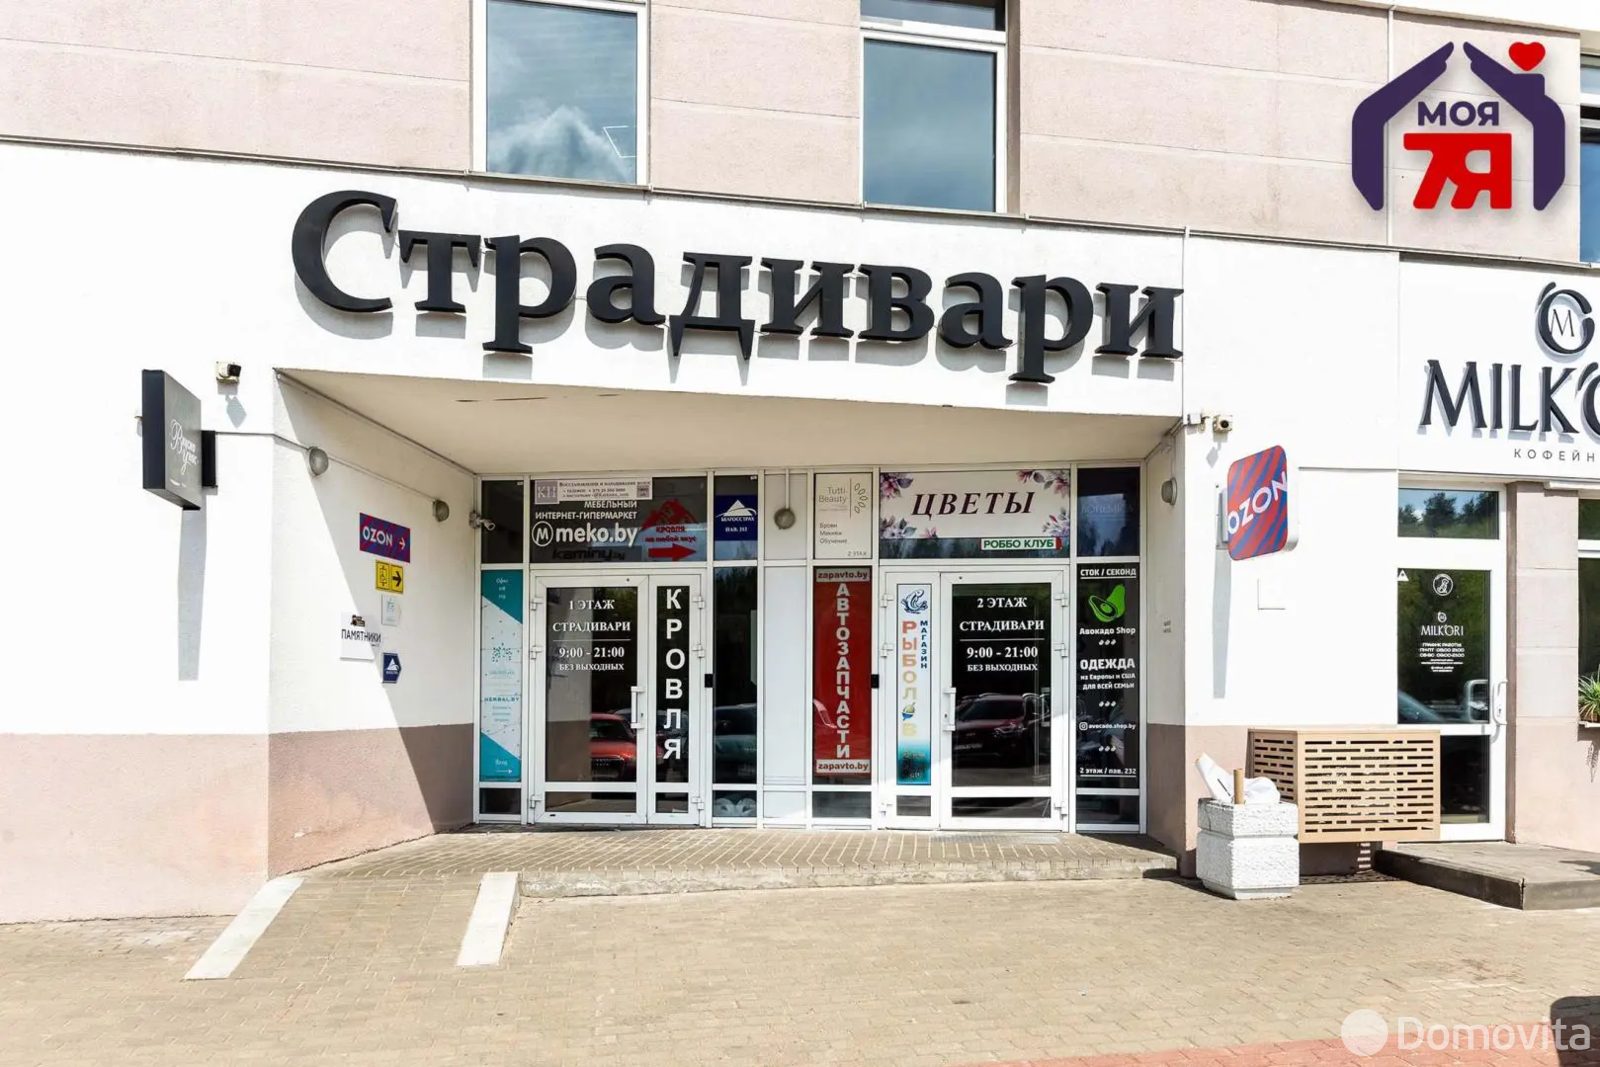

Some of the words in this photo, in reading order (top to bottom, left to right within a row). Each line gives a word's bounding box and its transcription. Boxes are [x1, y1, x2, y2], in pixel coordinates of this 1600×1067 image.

[290, 189, 1184, 383] Страдивари
[584, 500, 638, 509] МЕБЕЛЬНЫЙ
[818, 495, 847, 504] Beauty
[1228, 471, 1288, 534] OZON
[910, 491, 1035, 521] ЦВЕТЫ
[535, 511, 638, 520] ИНТЕРНЕТ-ГИПЕРМАРКЕТ
[362, 526, 393, 547] OZON
[555, 522, 638, 547] meko.by
[983, 540, 1022, 549] РОББО
[1024, 539, 1054, 548] КЛУБ
[818, 570, 868, 581] zapavto.by
[1106, 568, 1137, 576] СЕКОНД
[569, 600, 574, 610] 1
[577, 600, 615, 610] ЭТАЖ
[977, 598, 984, 608] 2
[987, 597, 1027, 608] ЭТАЖ
[552, 621, 631, 632] СТРАДИВАРИ
[959, 620, 1045, 632] СТРАДИВАРИ
[1116, 627, 1136, 635] Shop
[341, 629, 381, 643] ПАМЯТНИКИ
[920, 620, 928, 669] МАГАЗИН
[559, 647, 583, 658] 9:00
[594, 647, 625, 658] 21:00
[966, 647, 993, 659] 9:00
[1004, 646, 1038, 658] 21:00
[576, 663, 625, 671] ВЫХОДНЫХ
[985, 663, 1038, 672] ВЫХОДНЫХ
[1080, 658, 1135, 670] ОДЕЖДА
[663, 588, 685, 760] КРОВЛЯ
[836, 583, 850, 758] АВТОЗАПЧАСТИ
[818, 761, 869, 772] zapavto.by
